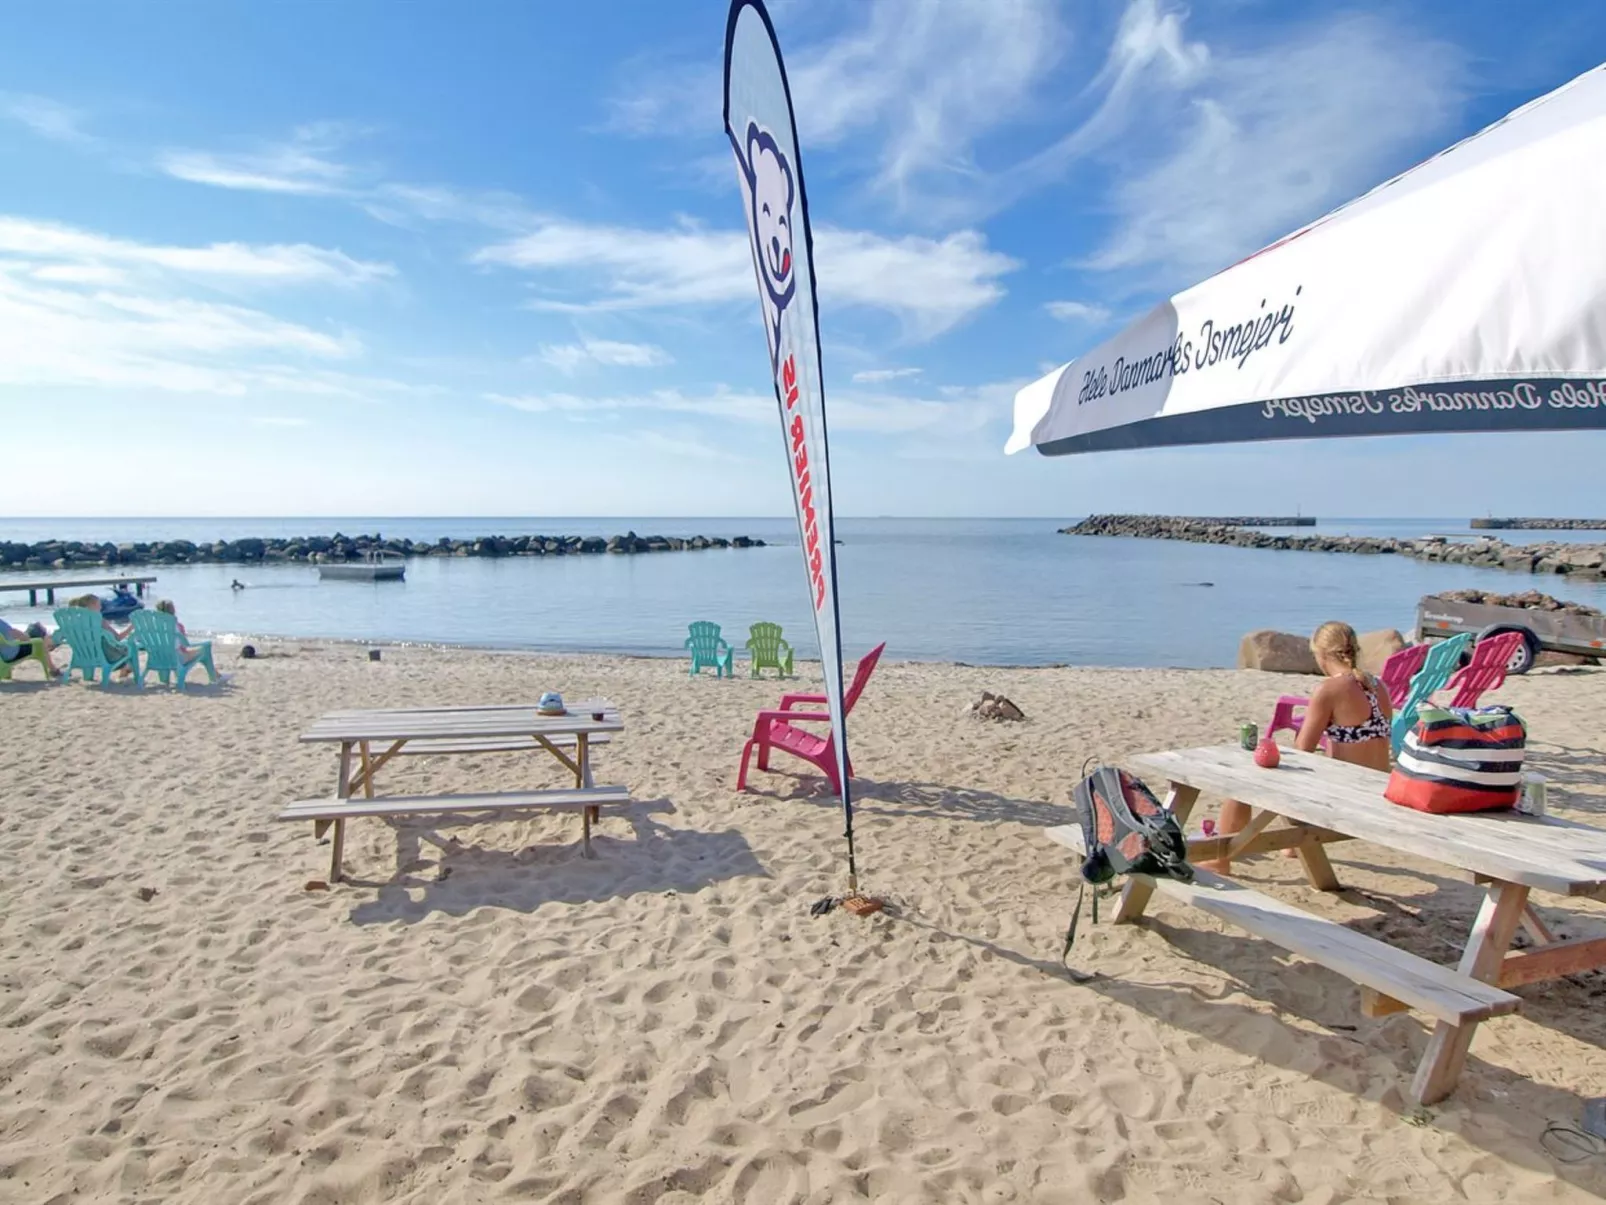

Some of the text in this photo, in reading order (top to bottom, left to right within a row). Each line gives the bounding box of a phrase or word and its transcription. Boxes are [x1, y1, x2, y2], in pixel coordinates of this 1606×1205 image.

[1078, 285, 1302, 405] Hele Danmarks Ismejeri
